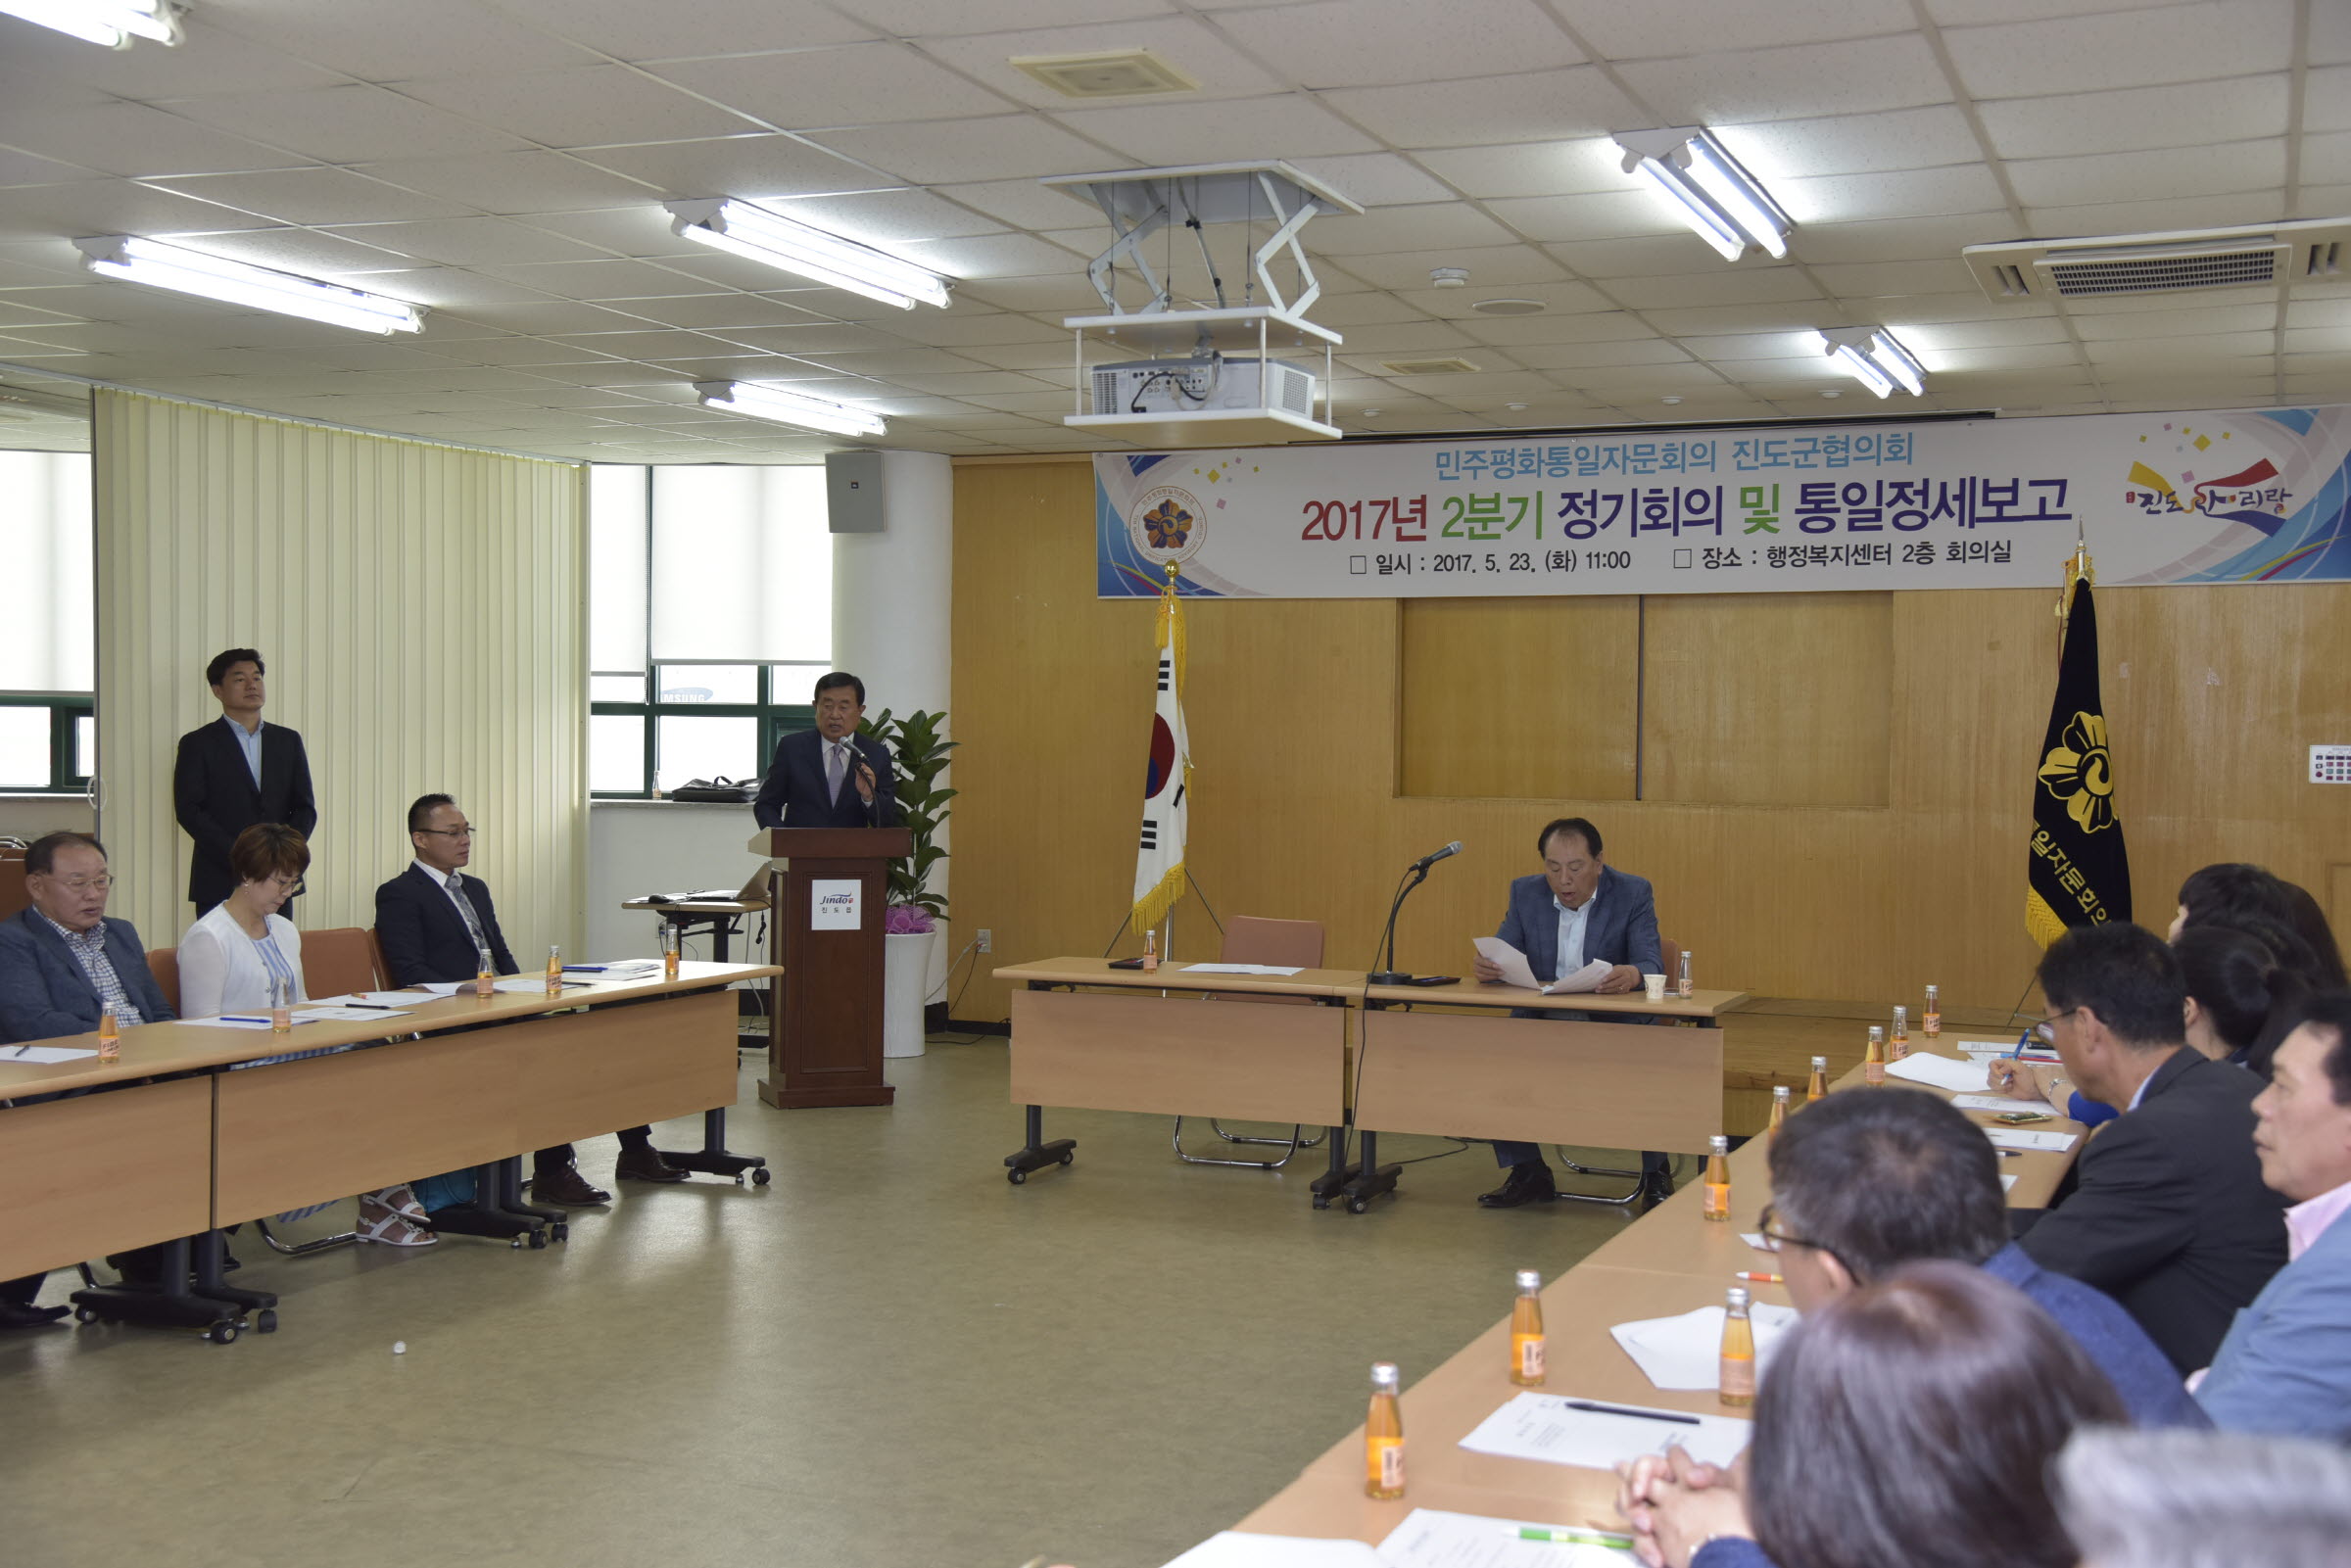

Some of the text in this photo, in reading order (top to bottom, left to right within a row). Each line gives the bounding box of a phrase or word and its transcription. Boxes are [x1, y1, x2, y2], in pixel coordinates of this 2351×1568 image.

[1435, 431, 1913, 481] 민주평화통일자문회의 진도군협의회
[1301, 476, 2072, 542] 2017년 2분기 정기회의 및 통일정세보고
[1375, 552, 1412, 576] 일시
[1433, 553, 1477, 574] 2017.
[1485, 553, 1502, 574] 5.
[1510, 552, 1536, 573] 23.
[1545, 548, 1577, 573] (화)
[1586, 550, 1632, 570] 11:00
[1703, 546, 1743, 570] 장소
[1767, 542, 1893, 568] 행정복지센터
[1902, 541, 1937, 565] 2층
[1946, 539, 2012, 564] 회의실
[2031, 820, 2111, 927] 일자문회의
[820, 895, 848, 905] Jindo
